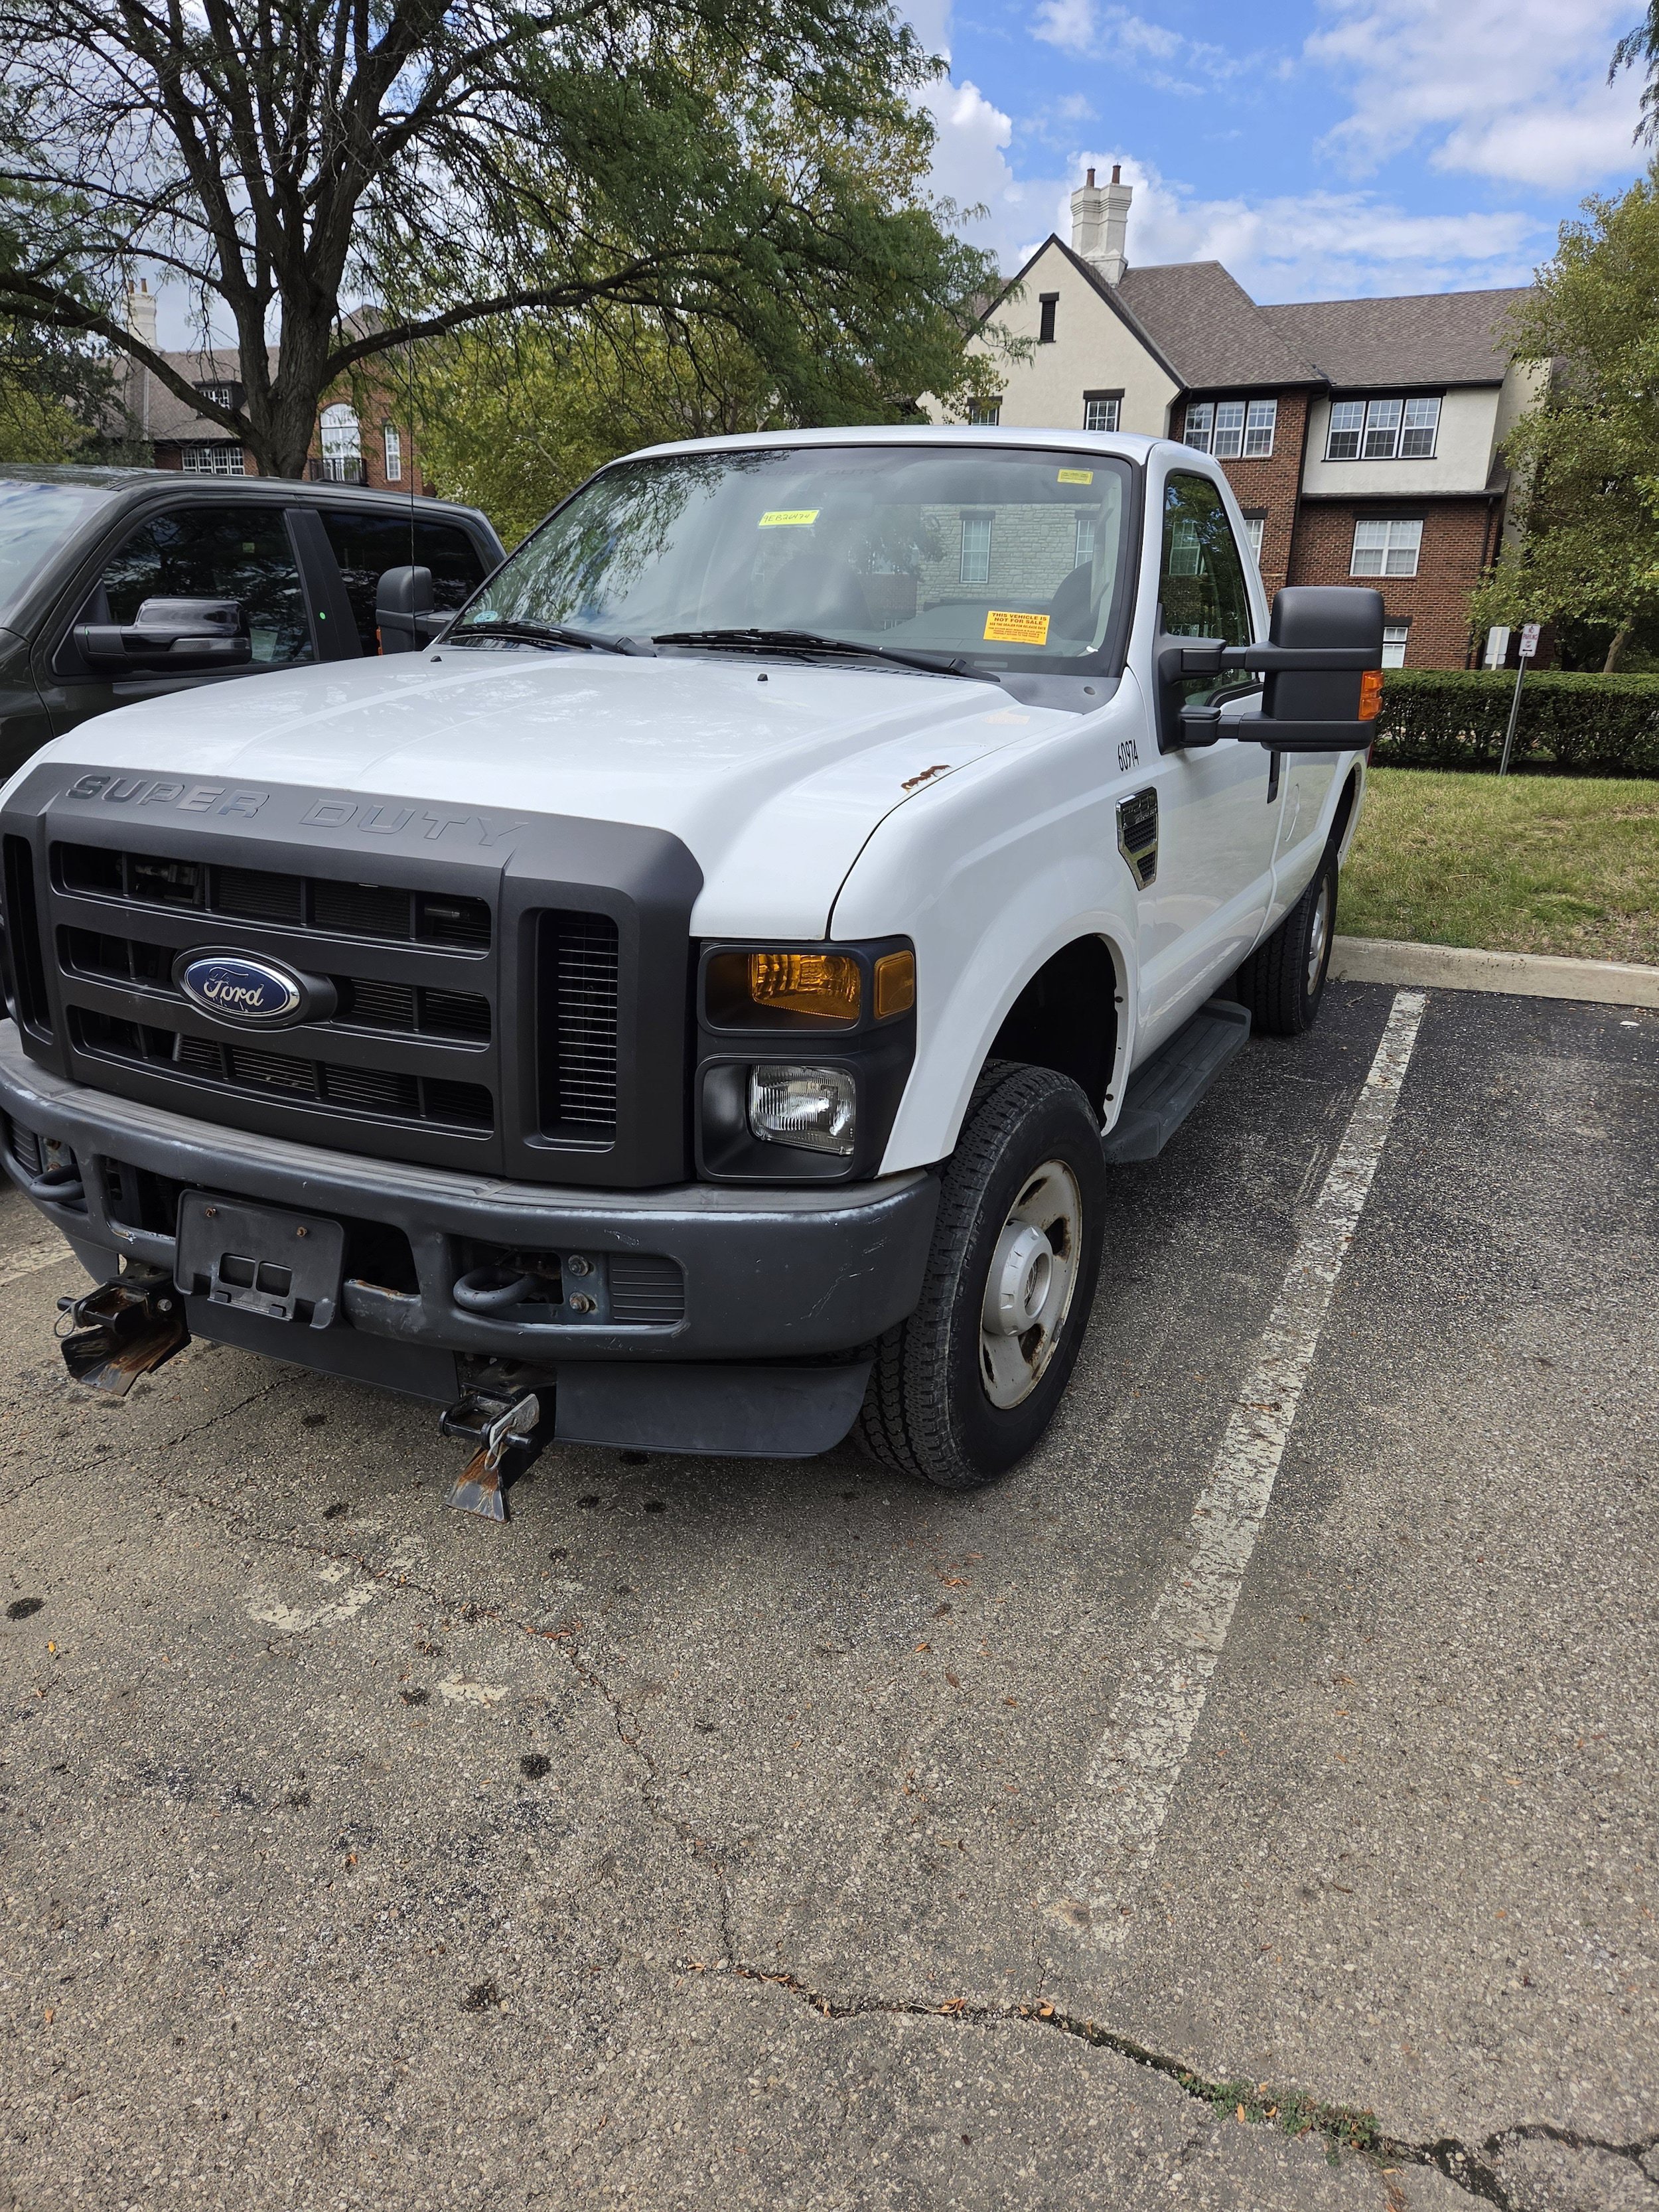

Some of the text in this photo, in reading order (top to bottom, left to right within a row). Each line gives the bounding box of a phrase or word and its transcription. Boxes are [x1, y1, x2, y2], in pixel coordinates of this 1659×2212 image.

[1118, 739, 1139, 772] 60974
[66, 774, 529, 846] SUPER DUTY
[203, 966, 265, 1007] Ford
